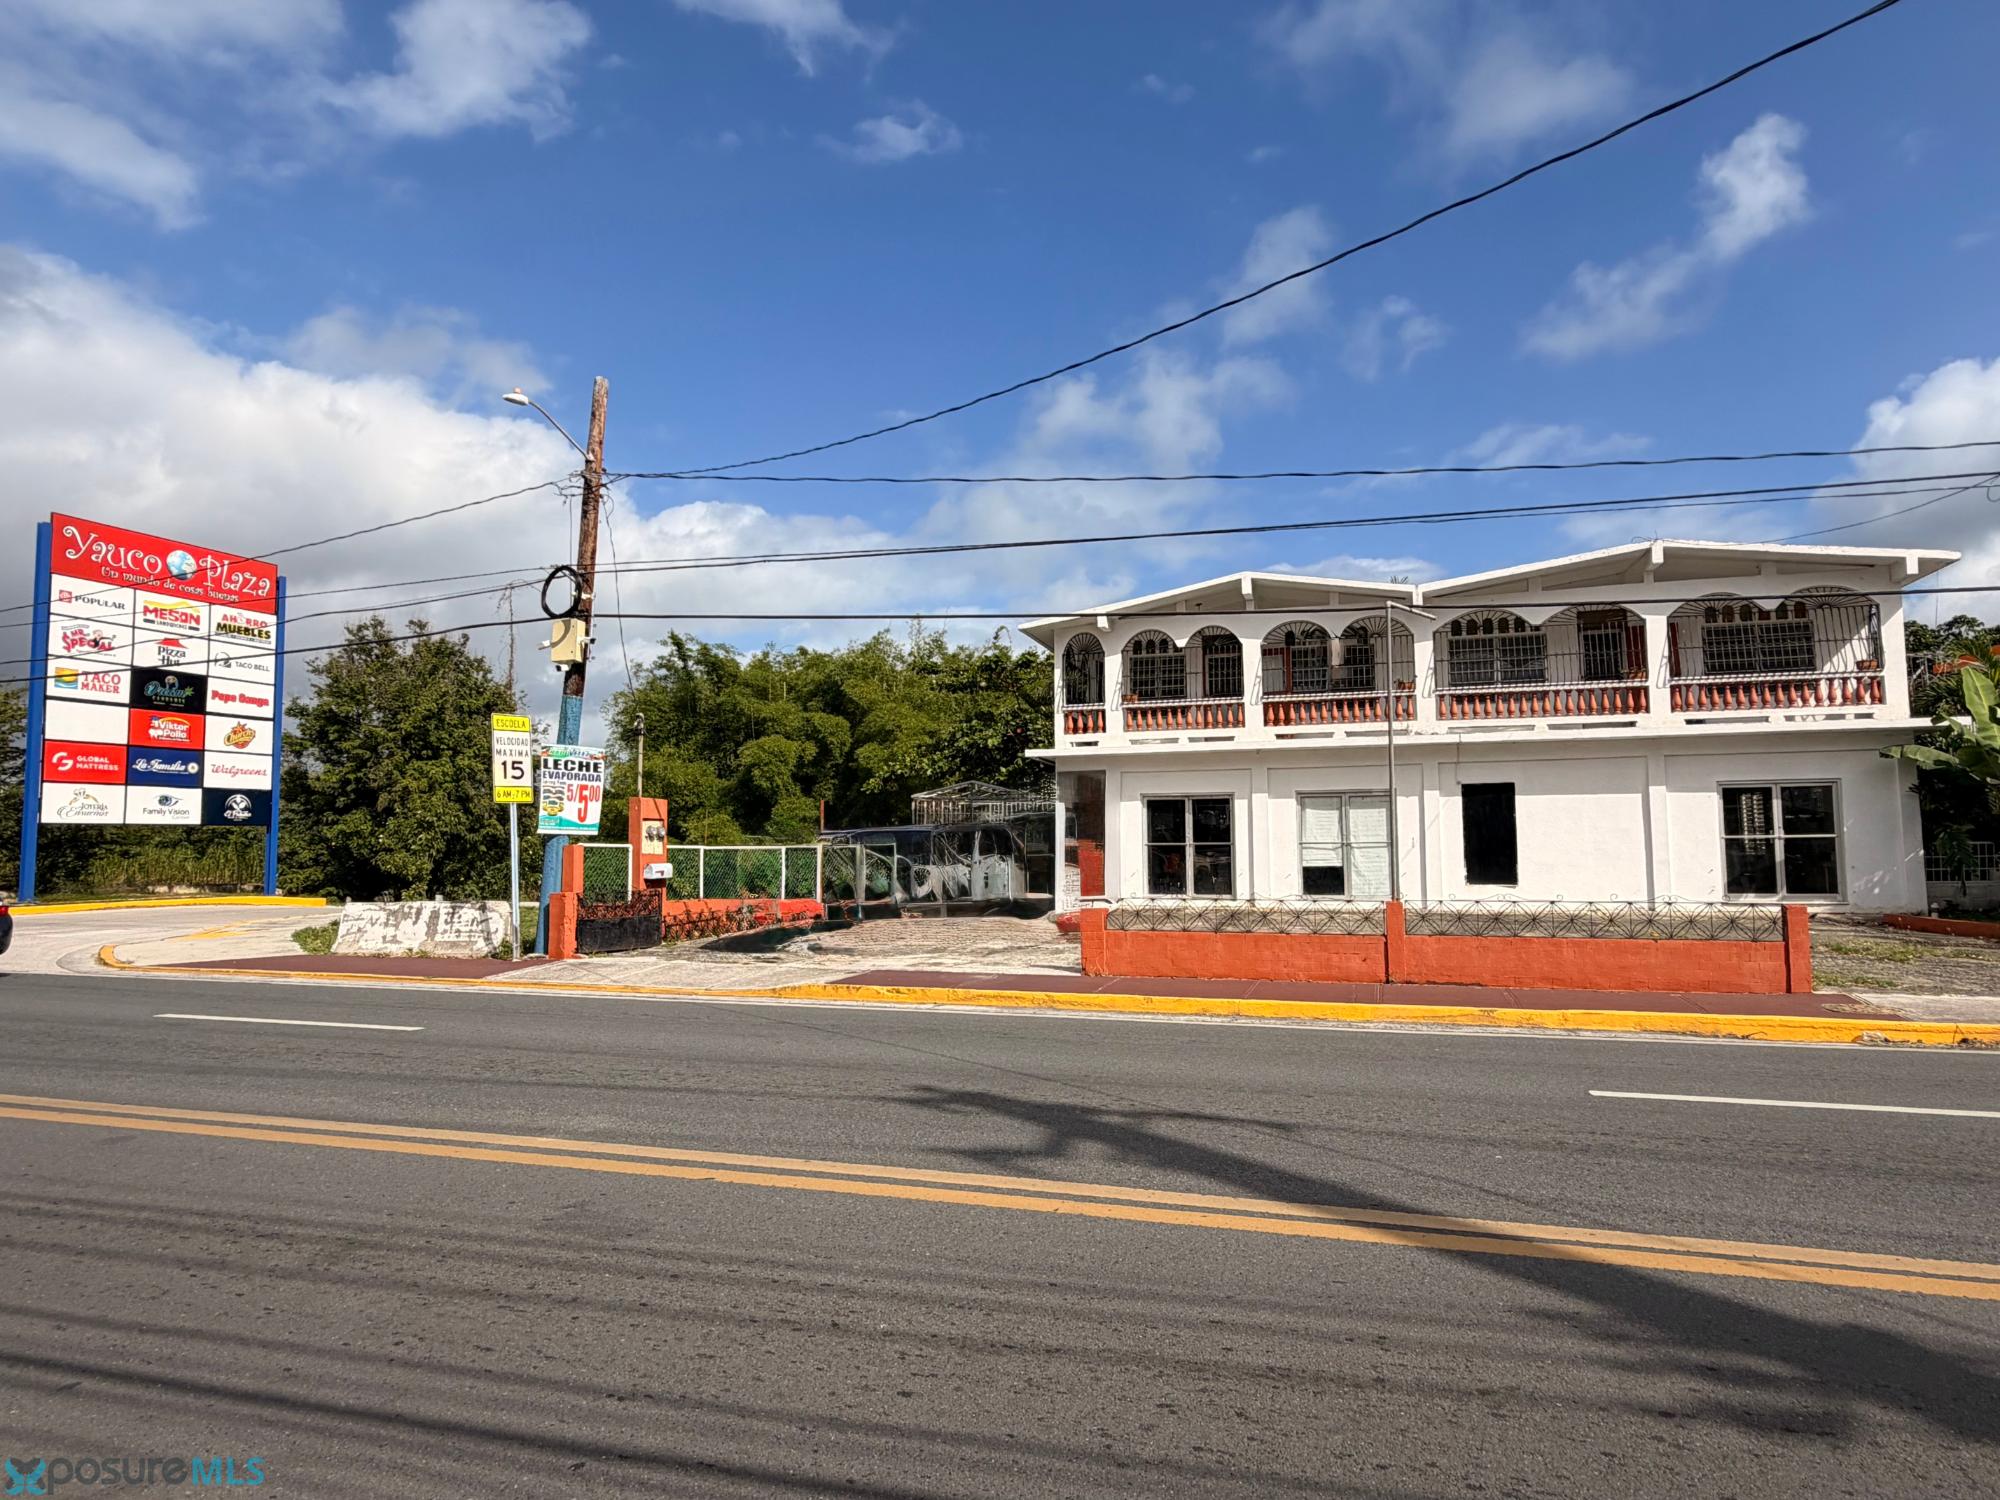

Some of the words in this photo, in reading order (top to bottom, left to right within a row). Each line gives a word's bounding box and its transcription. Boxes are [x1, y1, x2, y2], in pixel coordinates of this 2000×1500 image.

[63, 525, 162, 574] Yauco
[199, 554, 271, 597] Plaza
[101, 566, 119, 579] Un
[123, 570, 161, 587] mundo
[164, 577, 176, 590] de
[178, 582, 204, 596] cosas
[75, 595, 126, 610] POPULAR
[216, 622, 272, 640] MUEBLES
[157, 645, 187, 658] Pizza
[235, 661, 253, 670] TACO
[254, 664, 271, 672] BELL
[81, 670, 122, 686] TACO
[81, 682, 121, 694] MAKER
[163, 729, 188, 739] Pollo
[496, 736, 529, 747] VELOCIDAD
[76, 755, 110, 764] GLOBAL
[496, 748, 529, 758] MAXIMA
[76, 763, 120, 771] MATTRESS
[210, 764, 268, 778] Walgreens
[501, 760, 525, 780] 15
[542, 758, 603, 774] LECHE
[542, 770, 602, 783] EVAPORADA
[496, 789, 502, 798] 6
[142, 807, 167, 817] Family
[168, 808, 190, 816] Vision
